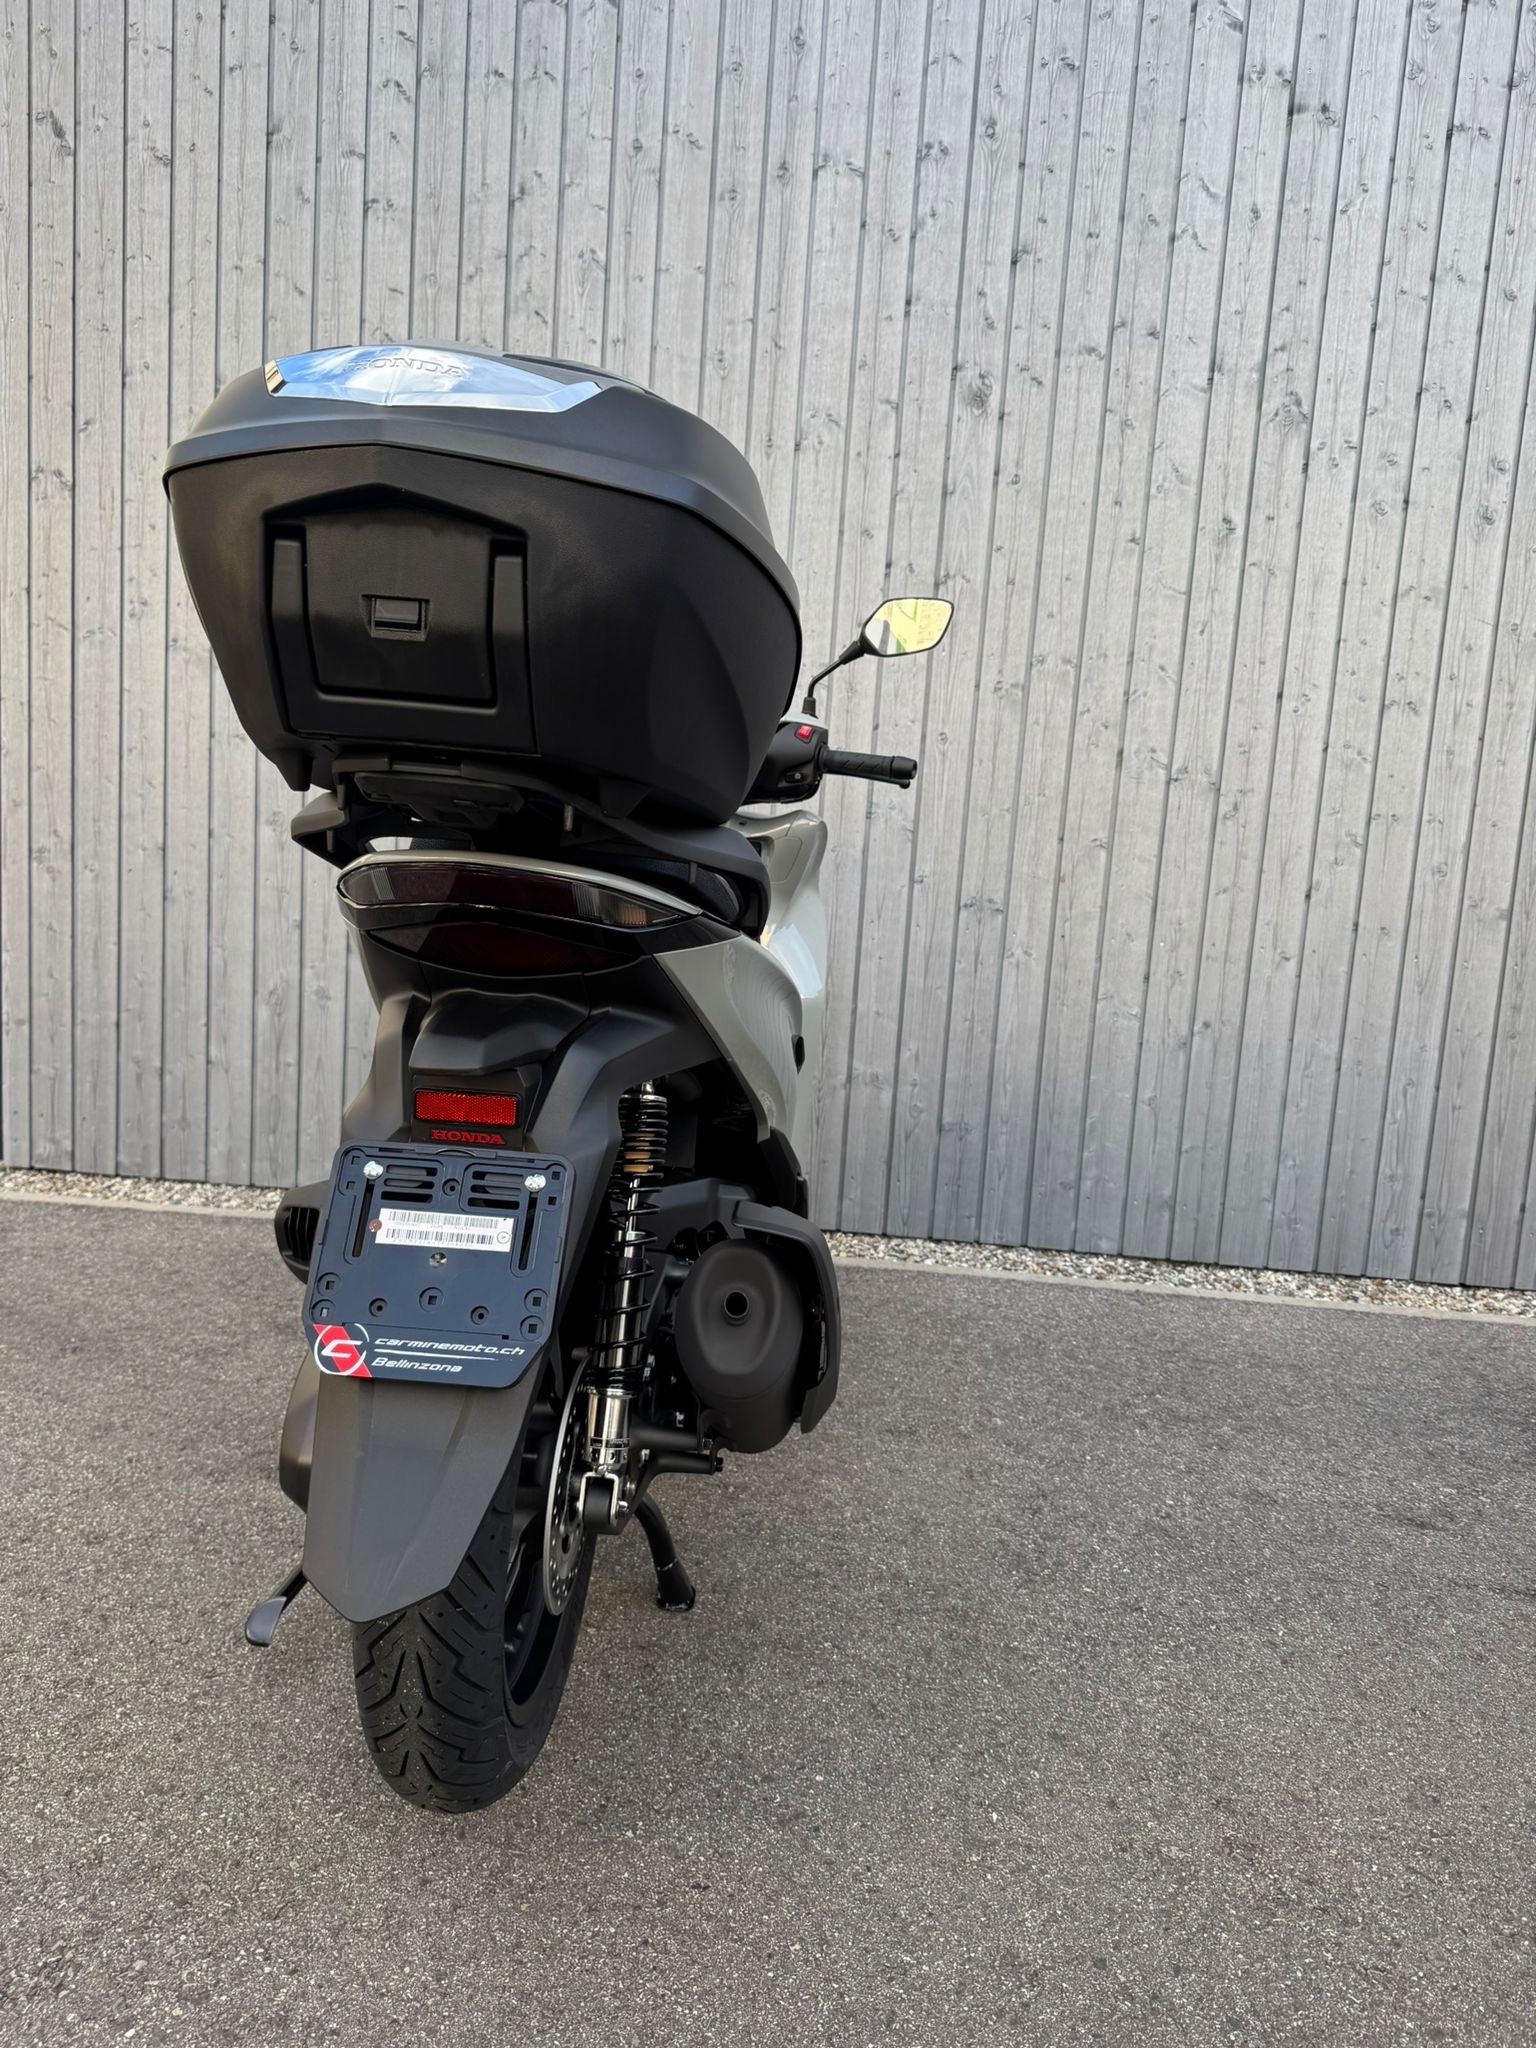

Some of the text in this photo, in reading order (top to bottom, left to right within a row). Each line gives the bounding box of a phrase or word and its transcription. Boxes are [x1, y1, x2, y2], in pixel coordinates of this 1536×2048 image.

[431, 1129, 506, 1145] HONDA
[374, 1337, 526, 1356] carminemoto.ch
[371, 1356, 463, 1373] Bellinzona
